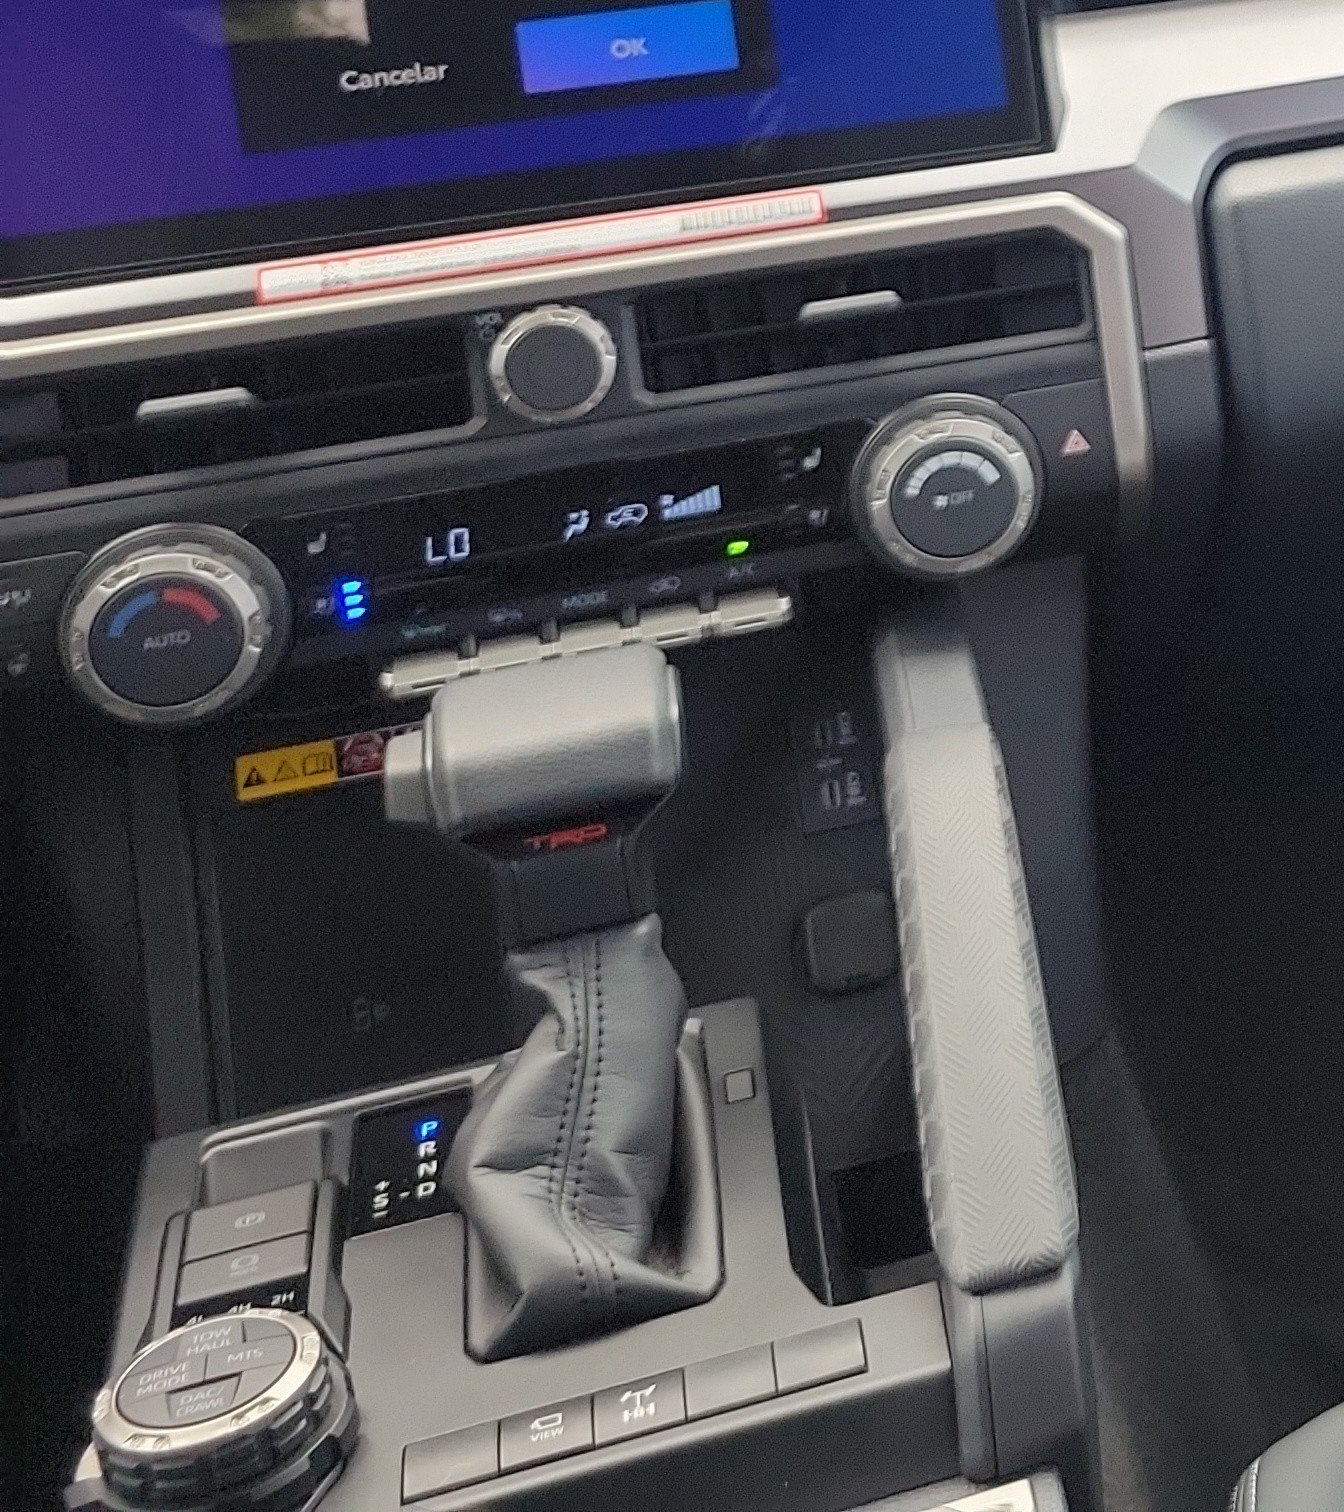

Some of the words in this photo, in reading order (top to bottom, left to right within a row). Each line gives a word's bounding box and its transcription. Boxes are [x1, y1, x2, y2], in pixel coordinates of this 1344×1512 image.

[610, 37, 648, 60] OK
[340, 61, 449, 93] Cancelar
[426, 527, 472, 565] LO
[562, 590, 609, 611] MODE
[143, 629, 191, 651] AUTO
[524, 822, 609, 850] TRD
[421, 1120, 438, 1138] P
[418, 1140, 437, 1159] R
[417, 1159, 438, 1178] N
[417, 1180, 437, 1199] D
[372, 1192, 389, 1209] S
[271, 1290, 295, 1306] 2H
[192, 1326, 232, 1344] TOW
[186, 1338, 234, 1357] HAUL
[228, 1347, 264, 1364] MTS
[138, 1361, 191, 1386] DRIVE
[135, 1372, 189, 1398] MODE
[175, 1397, 227, 1418] CRAWL
[530, 1426, 564, 1441] VIEW
